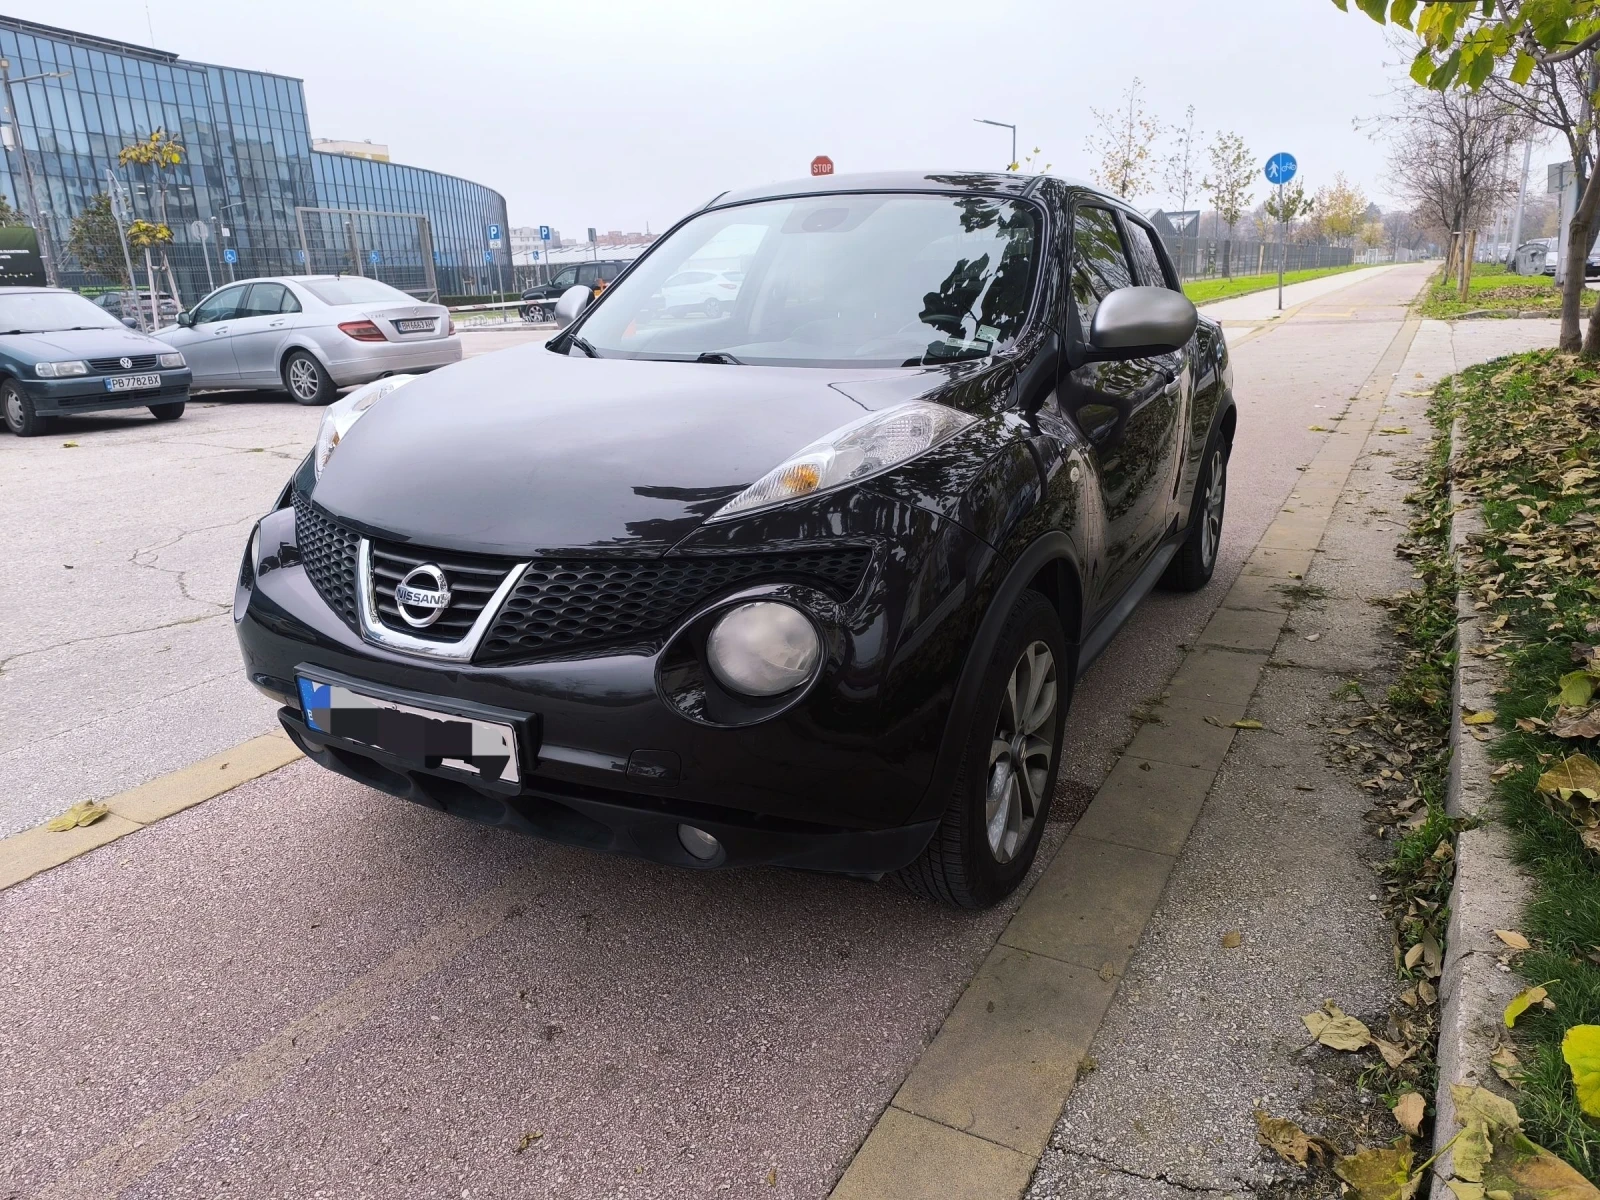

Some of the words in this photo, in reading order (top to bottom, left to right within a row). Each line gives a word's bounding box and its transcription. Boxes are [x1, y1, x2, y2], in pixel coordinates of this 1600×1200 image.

[813, 163, 832, 173] STOP
[490, 226, 498, 239] P
[541, 227, 548, 239] P
[112, 378, 125, 389] PB
[125, 376, 147, 387] 7782
[147, 375, 159, 385] BX
[397, 587, 441, 605] NISSAN
